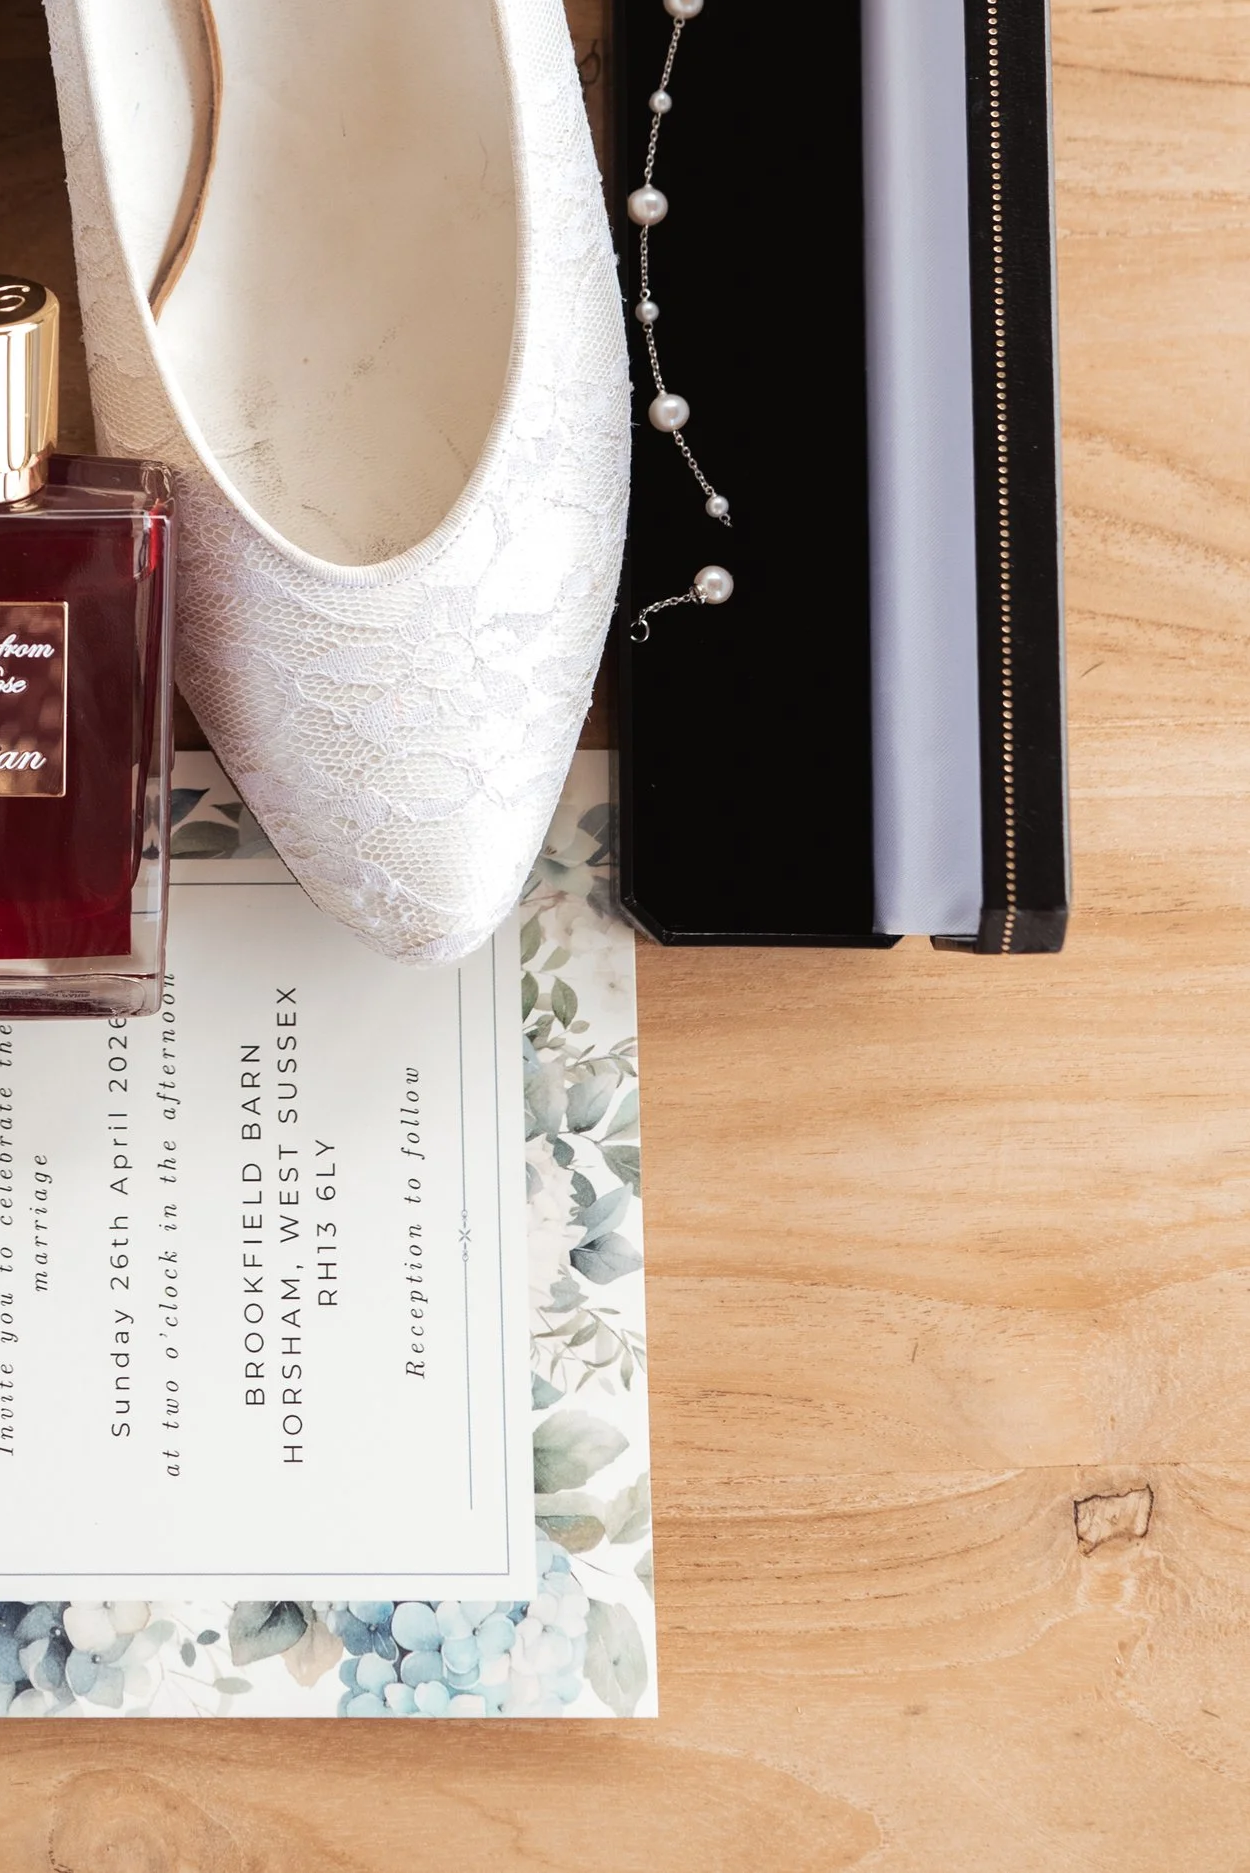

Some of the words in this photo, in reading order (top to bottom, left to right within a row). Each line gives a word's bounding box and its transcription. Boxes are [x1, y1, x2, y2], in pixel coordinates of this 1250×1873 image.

[156, 973, 180, 1120] afternoon
[239, 1044, 262, 1141] BARN
[275, 987, 299, 1124] SUSSEX
[107, 1113, 134, 1196] April
[399, 1067, 426, 1161] follow
[156, 1140, 178, 1184] the
[277, 1143, 300, 1244] WEST
[314, 1139, 337, 1202] 6LY
[403, 1177, 422, 1204] to
[28, 1154, 54, 1292] marriage
[108, 1215, 130, 1291] 26th
[158, 1203, 178, 1232] in
[316, 1222, 339, 1307] RH13
[0, 1292, 19, 1344] you
[157, 1250, 179, 1360] o’clock
[241, 1162, 266, 1406] BROOKFIELD
[403, 1223, 429, 1380] Reception
[109, 1309, 135, 1438] Sunday
[161, 1380, 180, 1430] two
[279, 1264, 305, 1464] HORSHAM,
[161, 1449, 181, 1477] at
